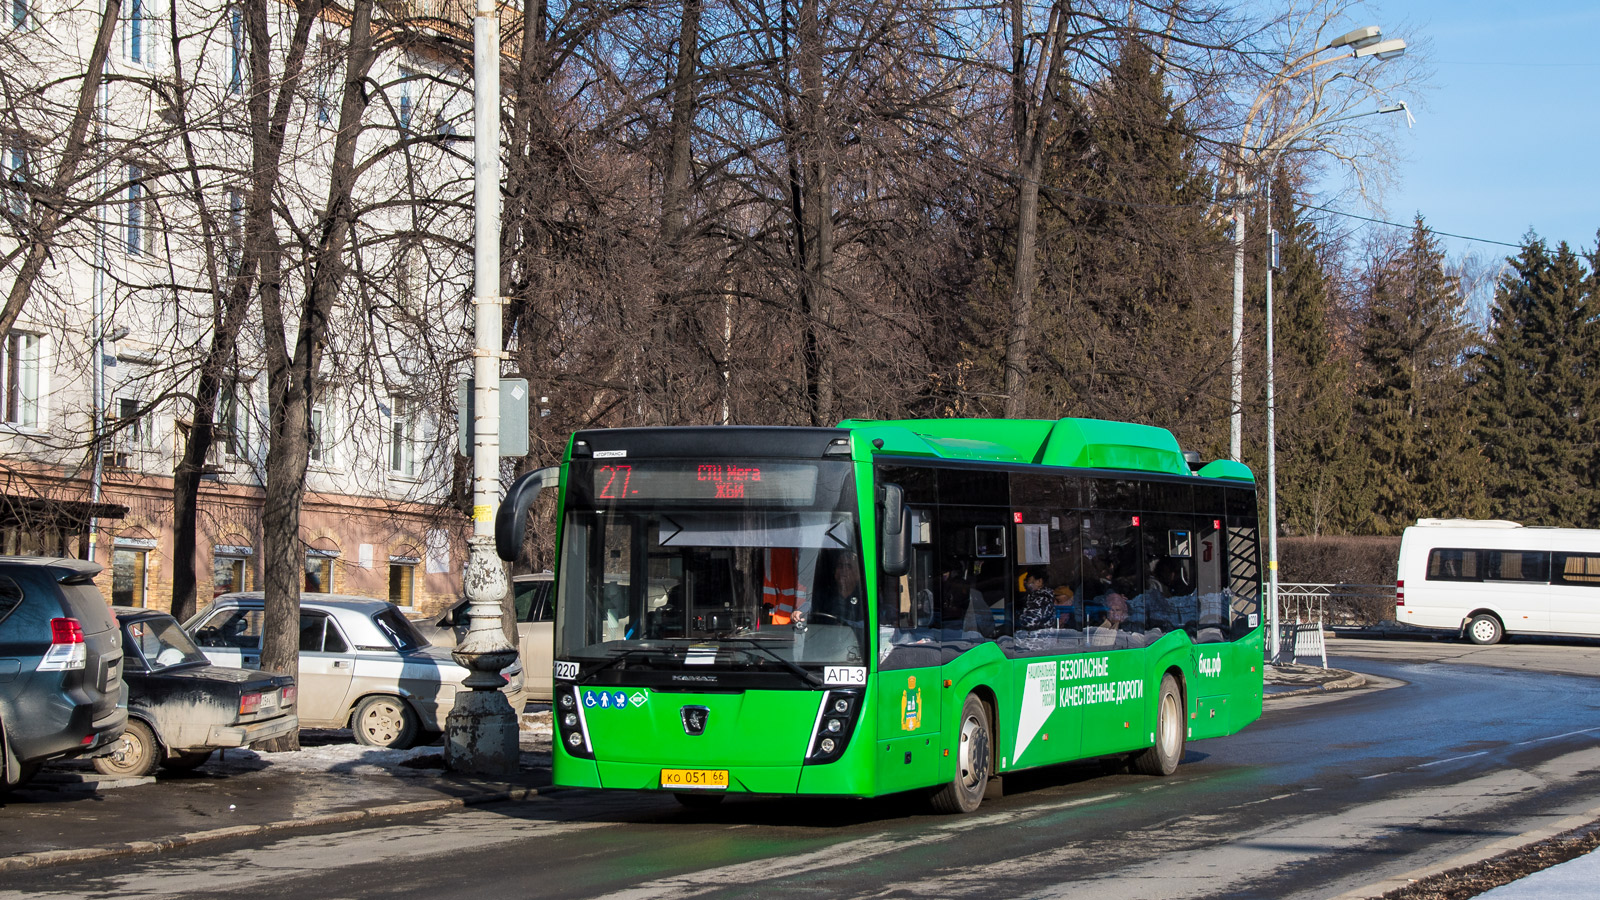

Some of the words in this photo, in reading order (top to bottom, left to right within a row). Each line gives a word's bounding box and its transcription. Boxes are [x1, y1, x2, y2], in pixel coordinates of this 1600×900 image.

[697, 464, 723, 482] СТЦ
[727, 464, 761, 481] Мега
[714, 481, 744, 499] ЖБИ
[554, 662, 576, 679] 1220
[1060, 656, 1109, 681] БЕЗОПАСНЫЕ
[1199, 651, 1222, 678] бкд.рф
[826, 668, 864, 683] АП-3
[1059, 681, 1116, 708] КАЧЕСТВЕННЫЕ
[1115, 679, 1144, 705] ДОРОГИ
[685, 771, 706, 783] 051
[713, 771, 724, 781] 66
